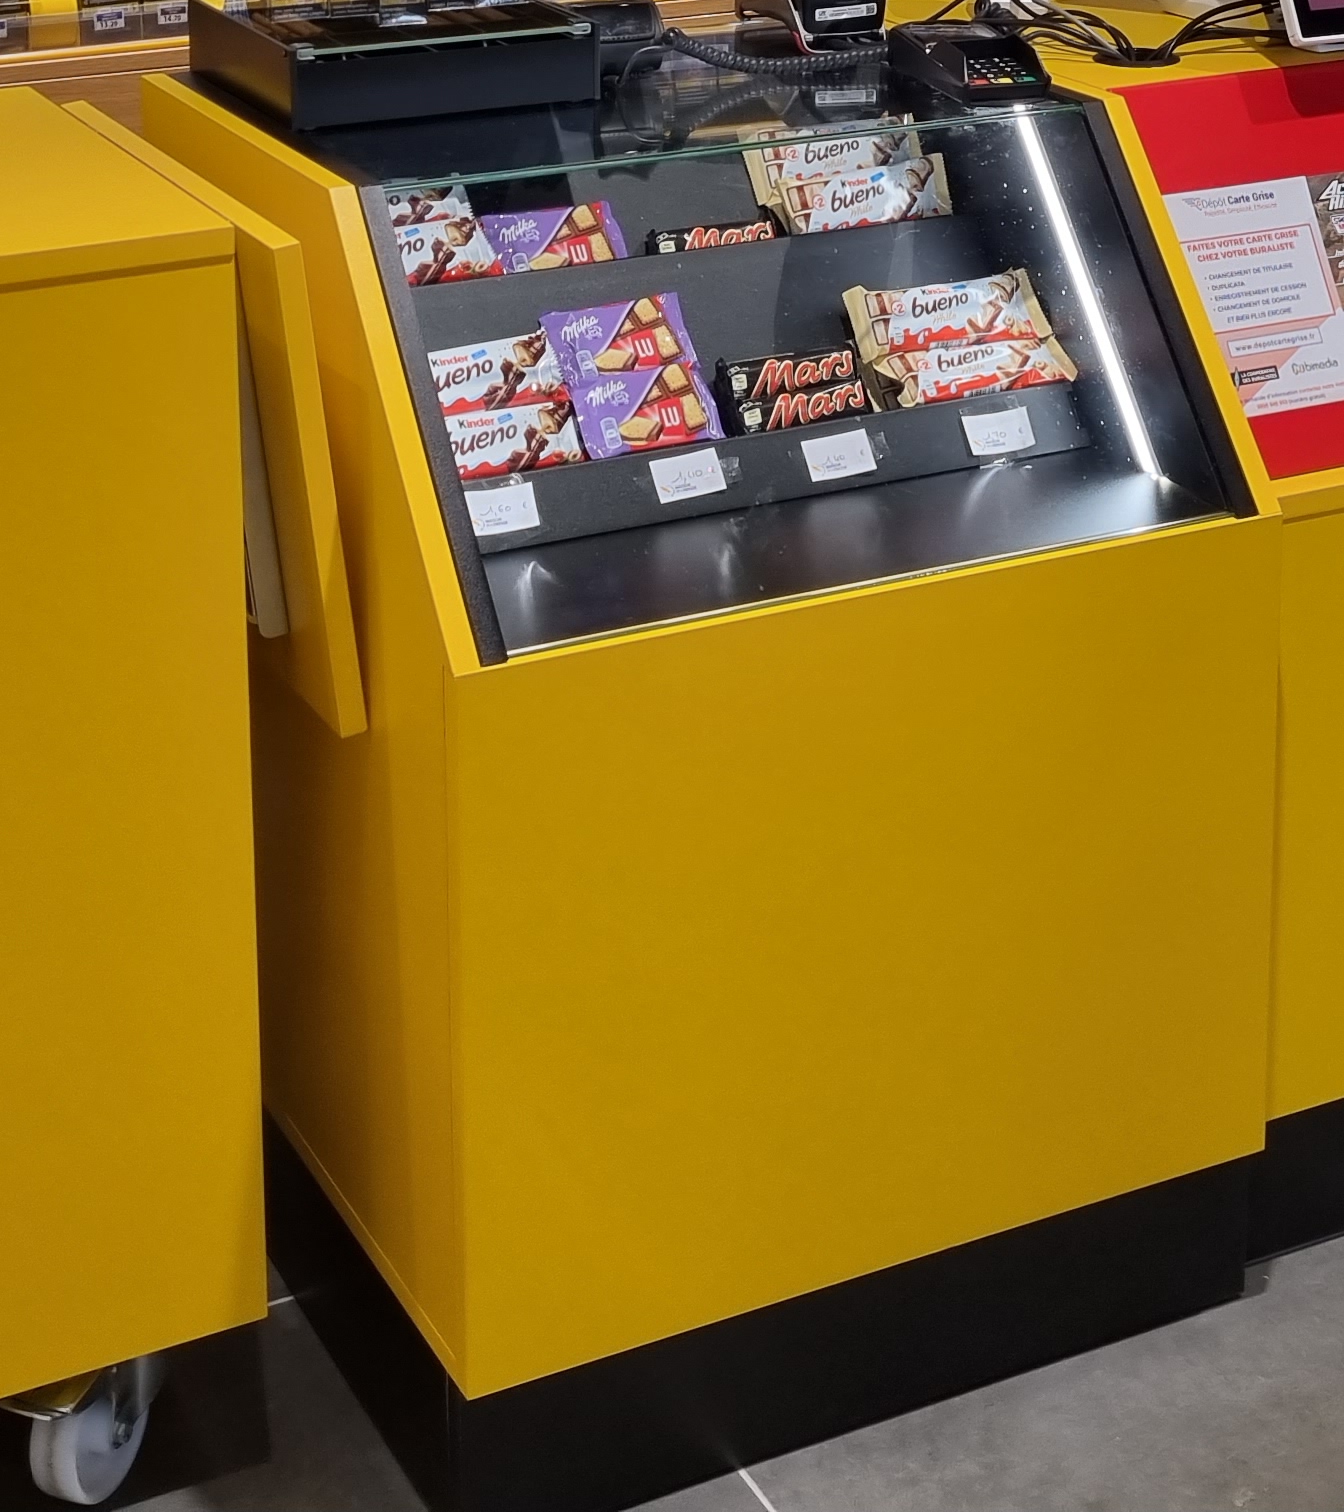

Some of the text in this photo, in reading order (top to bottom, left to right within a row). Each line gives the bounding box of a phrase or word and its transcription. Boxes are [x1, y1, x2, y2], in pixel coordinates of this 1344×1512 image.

[804, 140, 860, 164] bueno
[840, 178, 869, 189] Kinder
[831, 183, 885, 213] bueno
[1227, 190, 1275, 206] Carte Grise
[499, 218, 538, 244] Milka
[685, 220, 776, 251] Mars
[1187, 229, 1300, 254] FAITES VOTRE CARTE GRISE
[570, 243, 589, 263] LU
[1197, 241, 1296, 263] CHEZ VOTRE BURALISTE
[1208, 262, 1294, 281] CHANGEMENT DE TITULAIRE
[1211, 281, 1246, 292] DUPLICATA
[1215, 282, 1307, 302] ENREGISTREMENT DE CESSION
[911, 290, 969, 319] bueno
[1217, 300, 1261, 313] CHANGEMENT
[1271, 293, 1301, 304] DOMICILE
[1268, 307, 1292, 318] ENCORE
[562, 315, 599, 343] Milka
[636, 338, 655, 359] LU
[1234, 332, 1316, 352] www.depotcartegrise.fr
[431, 353, 471, 367] Kinder
[937, 345, 995, 368] bueno
[435, 357, 494, 393] ueno
[756, 350, 854, 399] Mars
[587, 380, 627, 408] Milka
[768, 379, 865, 430] Mars
[457, 416, 496, 429] Kinder
[664, 405, 680, 428] LU
